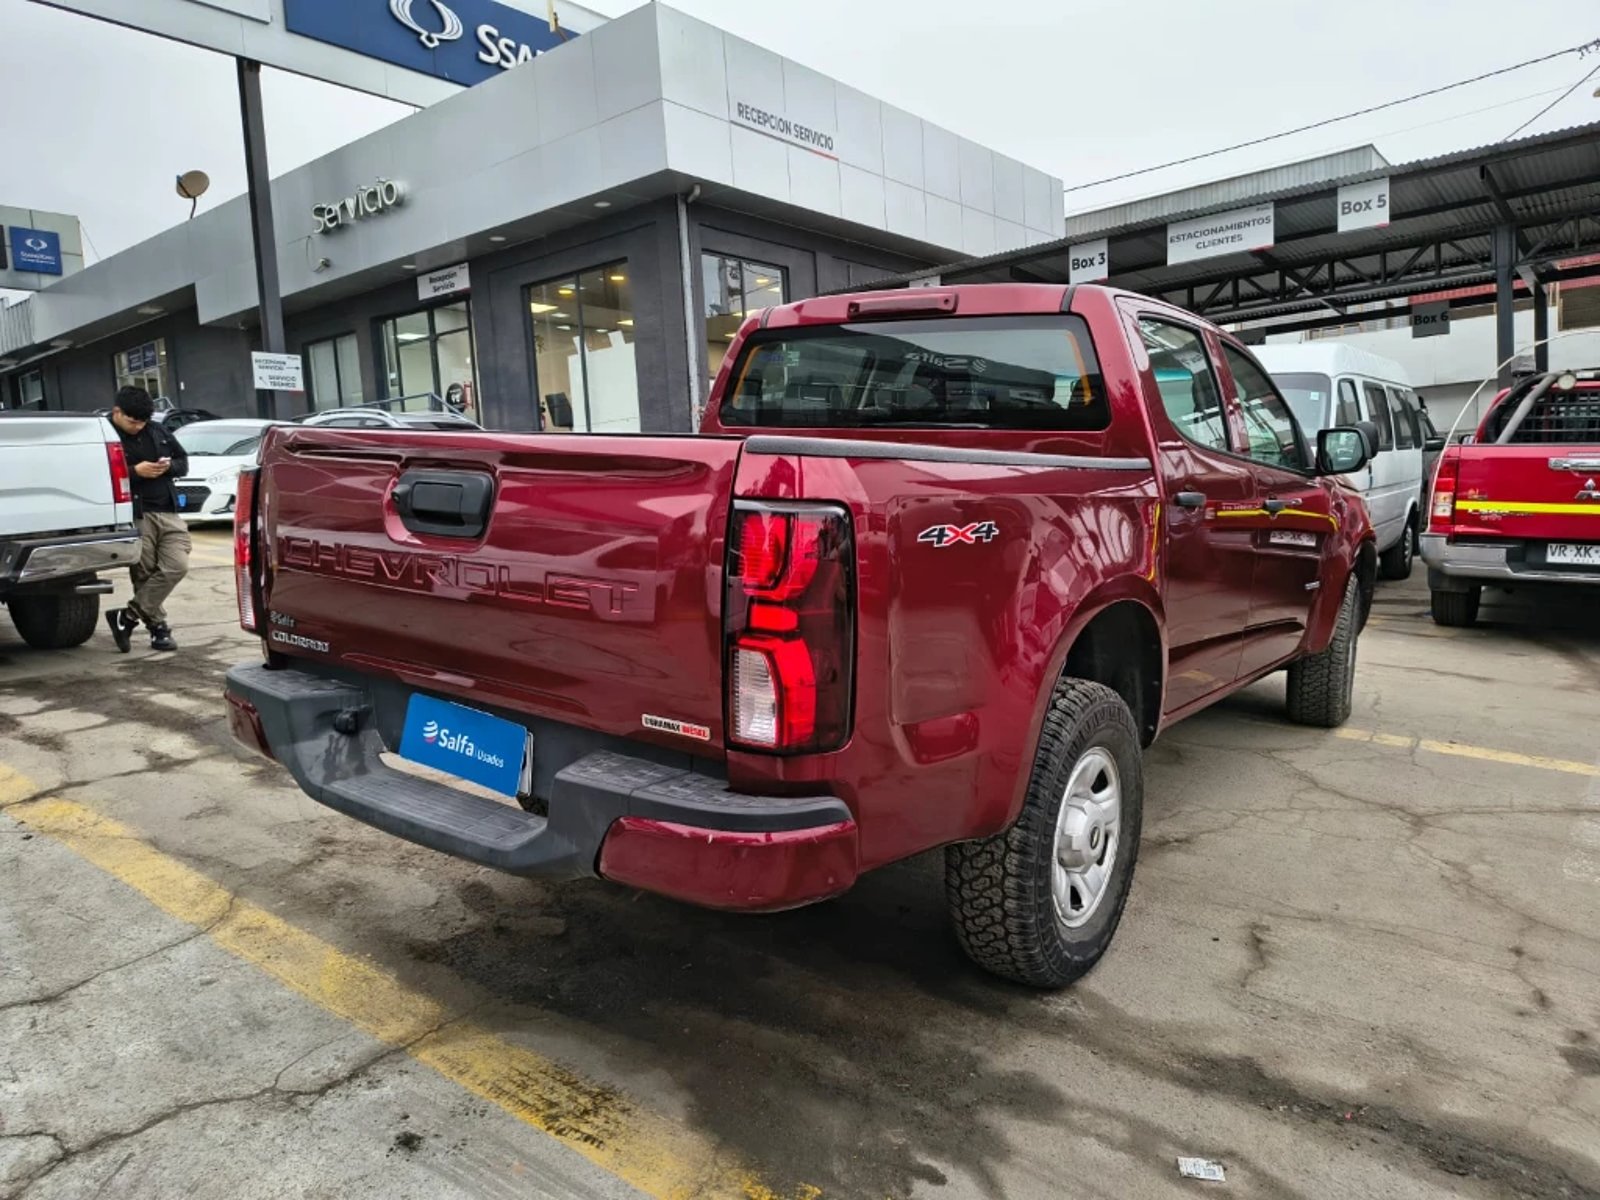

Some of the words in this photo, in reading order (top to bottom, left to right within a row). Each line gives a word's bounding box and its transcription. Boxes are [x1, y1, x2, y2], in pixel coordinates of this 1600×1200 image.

[476, 23, 545, 70] SSA
[737, 102, 792, 136] RECEPCION
[793, 123, 834, 151] SERVICIO
[312, 177, 398, 234] Servicio
[1341, 199, 1373, 216] Box
[1376, 193, 1387, 208] 5
[1169, 215, 1271, 244] ESTACIONAMIENTOS
[1195, 233, 1243, 250] CLIENTES
[1071, 256, 1095, 271] Box
[1097, 251, 1106, 265] 3
[1413, 314, 1437, 326] Box
[1440, 310, 1449, 322] 6
[280, 536, 639, 614] CHEVROLET
[272, 630, 329, 652] COLORADO
[438, 729, 475, 757] Salfa
[477, 750, 504, 768] Usados
